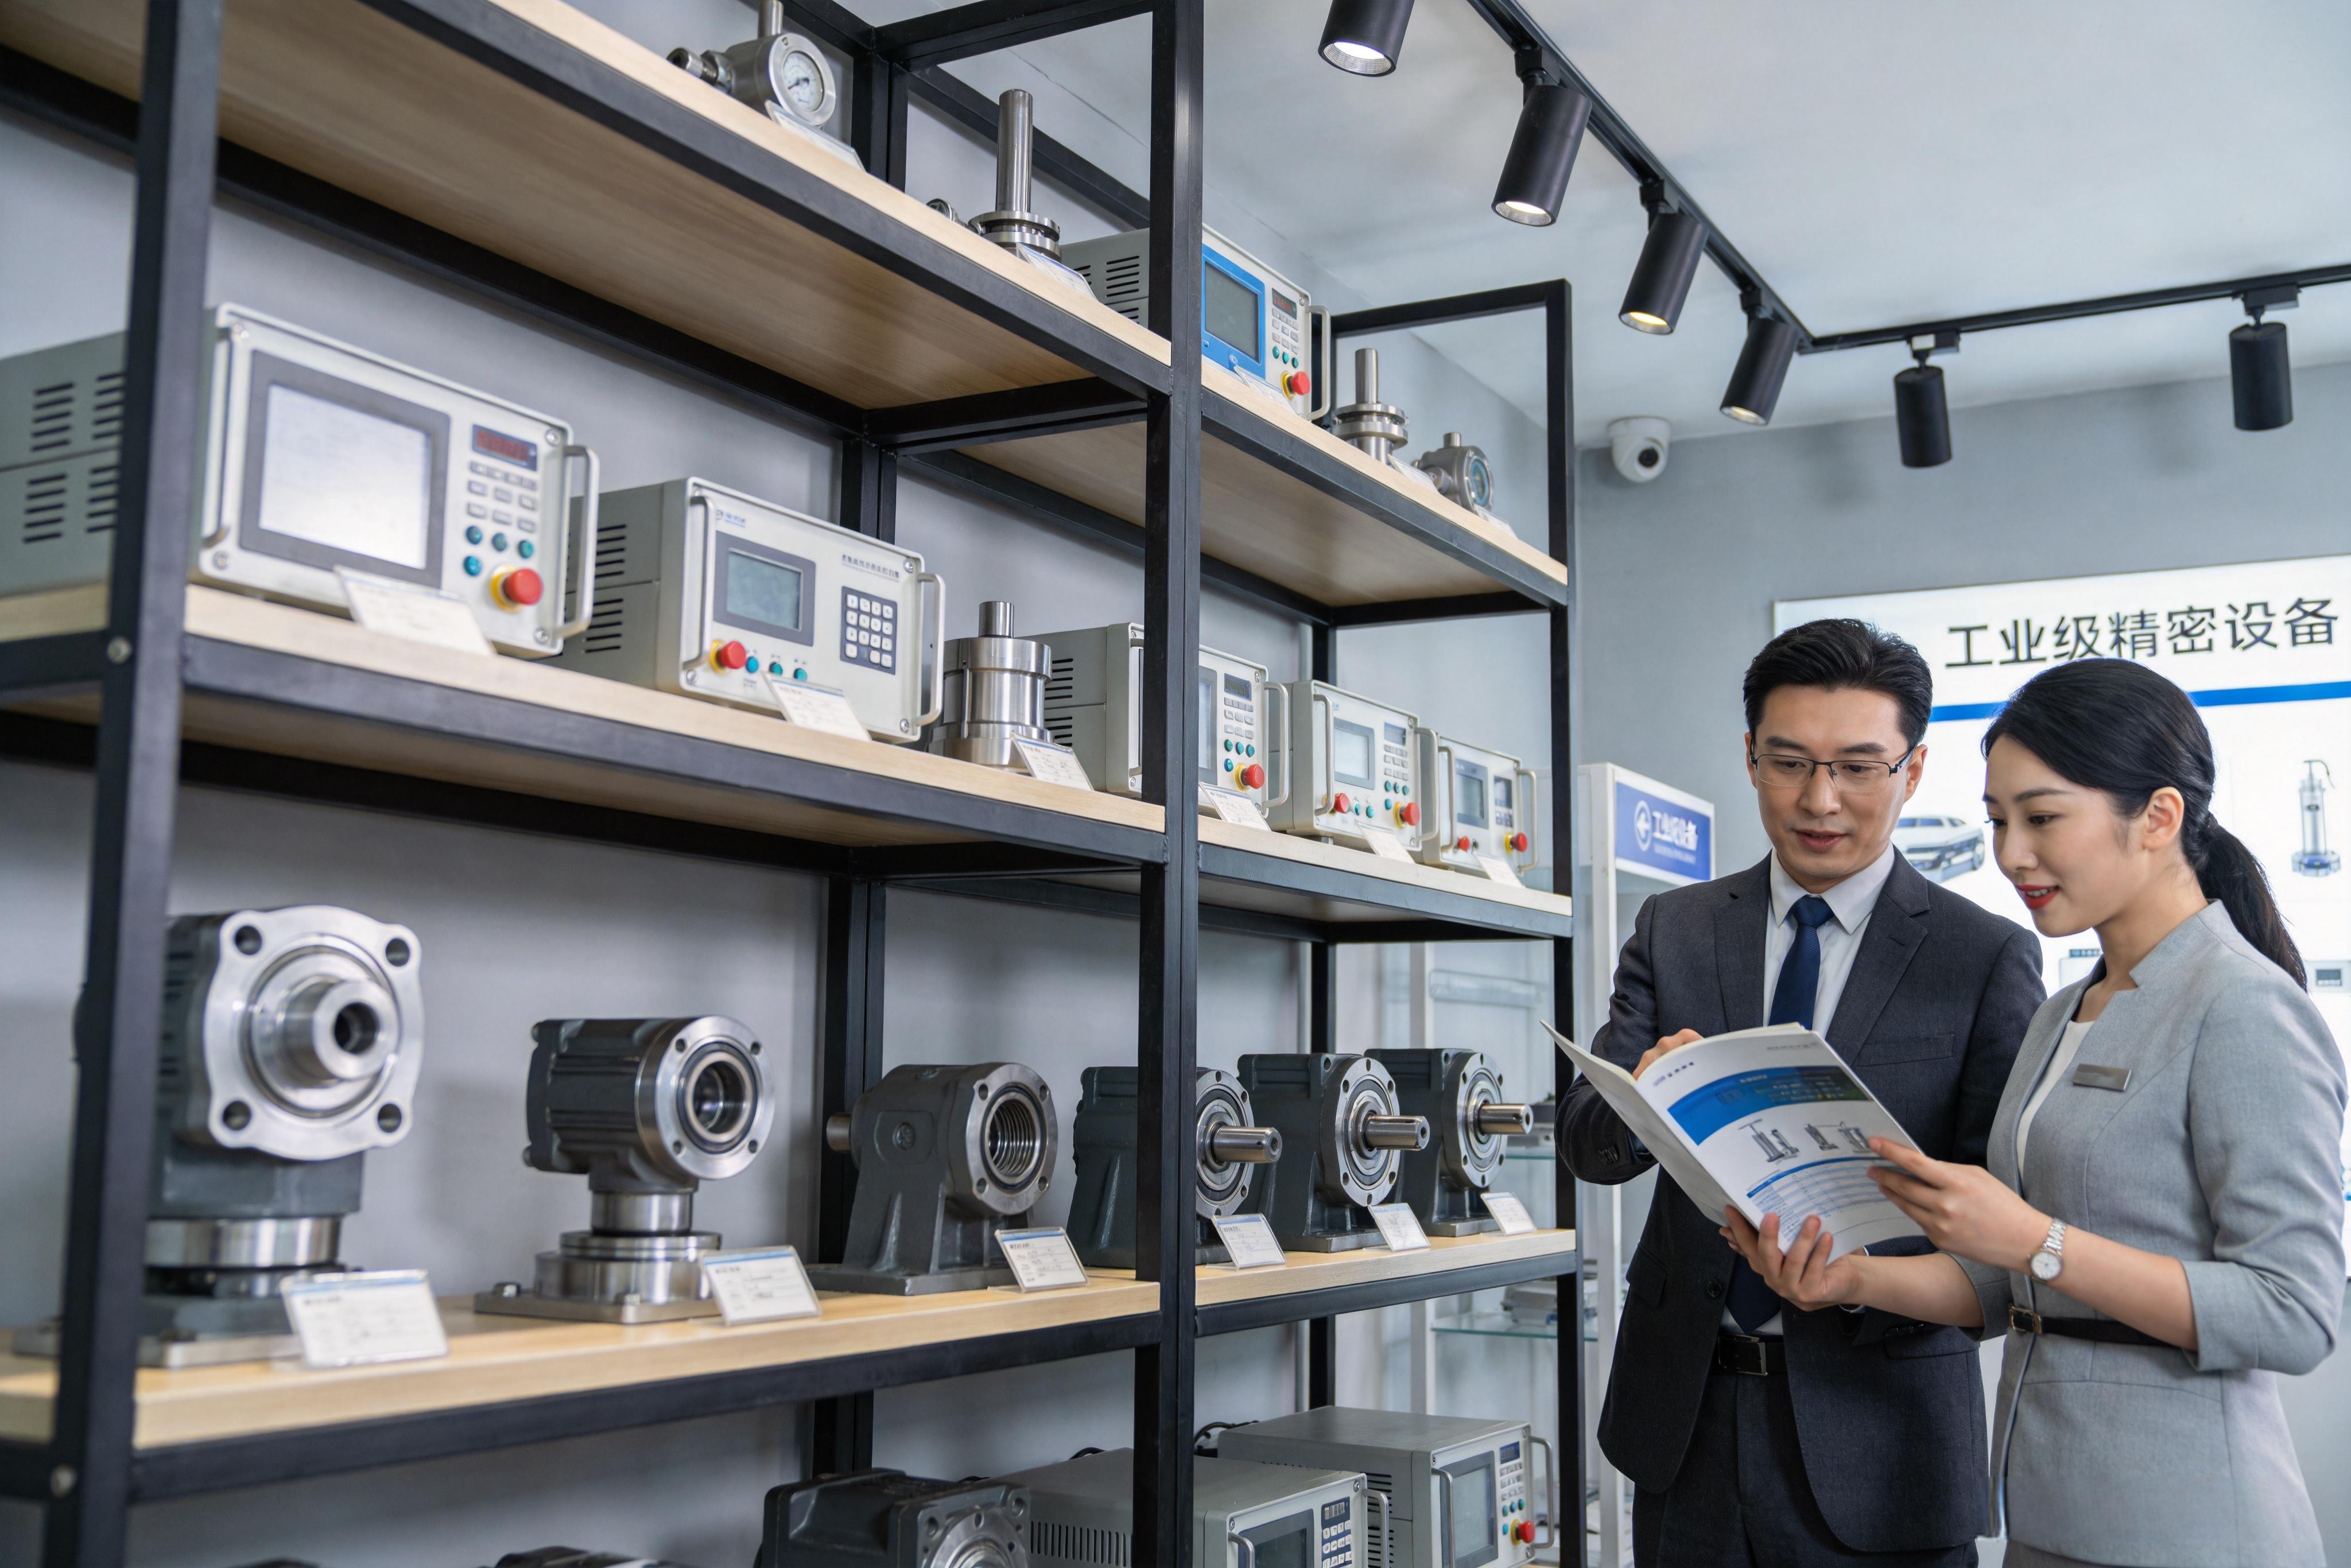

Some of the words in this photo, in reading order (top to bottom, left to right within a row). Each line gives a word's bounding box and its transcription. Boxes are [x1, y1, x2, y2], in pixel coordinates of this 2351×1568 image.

[1945, 597, 2338, 668] 工业级精密设备
